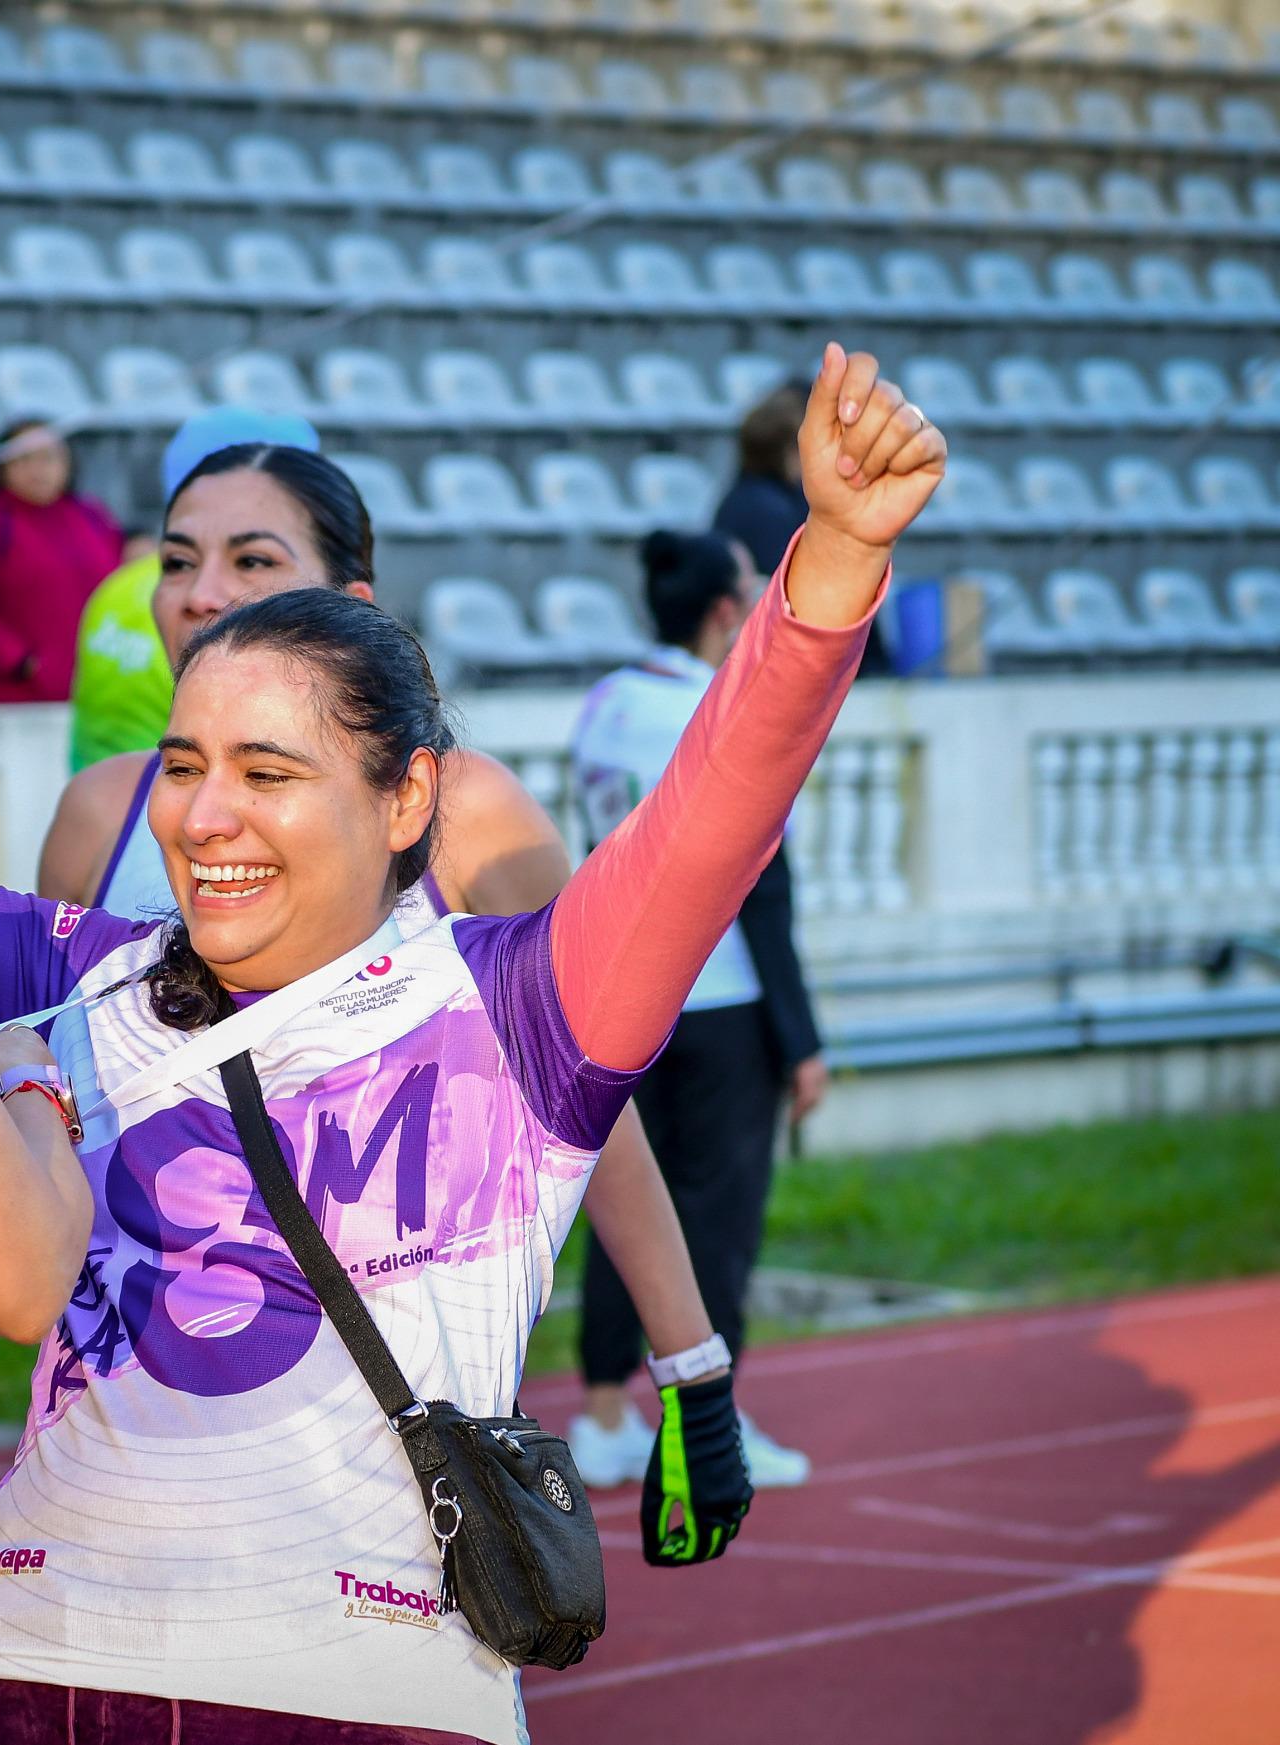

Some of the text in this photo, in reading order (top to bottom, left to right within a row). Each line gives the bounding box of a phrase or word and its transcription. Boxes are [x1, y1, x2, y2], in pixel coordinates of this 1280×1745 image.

[319, 974, 416, 1008] INSTITUTO MUNICIPAL
[332, 985, 407, 1015] DE LAS MUJERES
[345, 997, 399, 1018] DE XALAPA
[365, 1244, 434, 1278] Edición
[344, 1596, 438, 1628] y transparencia
